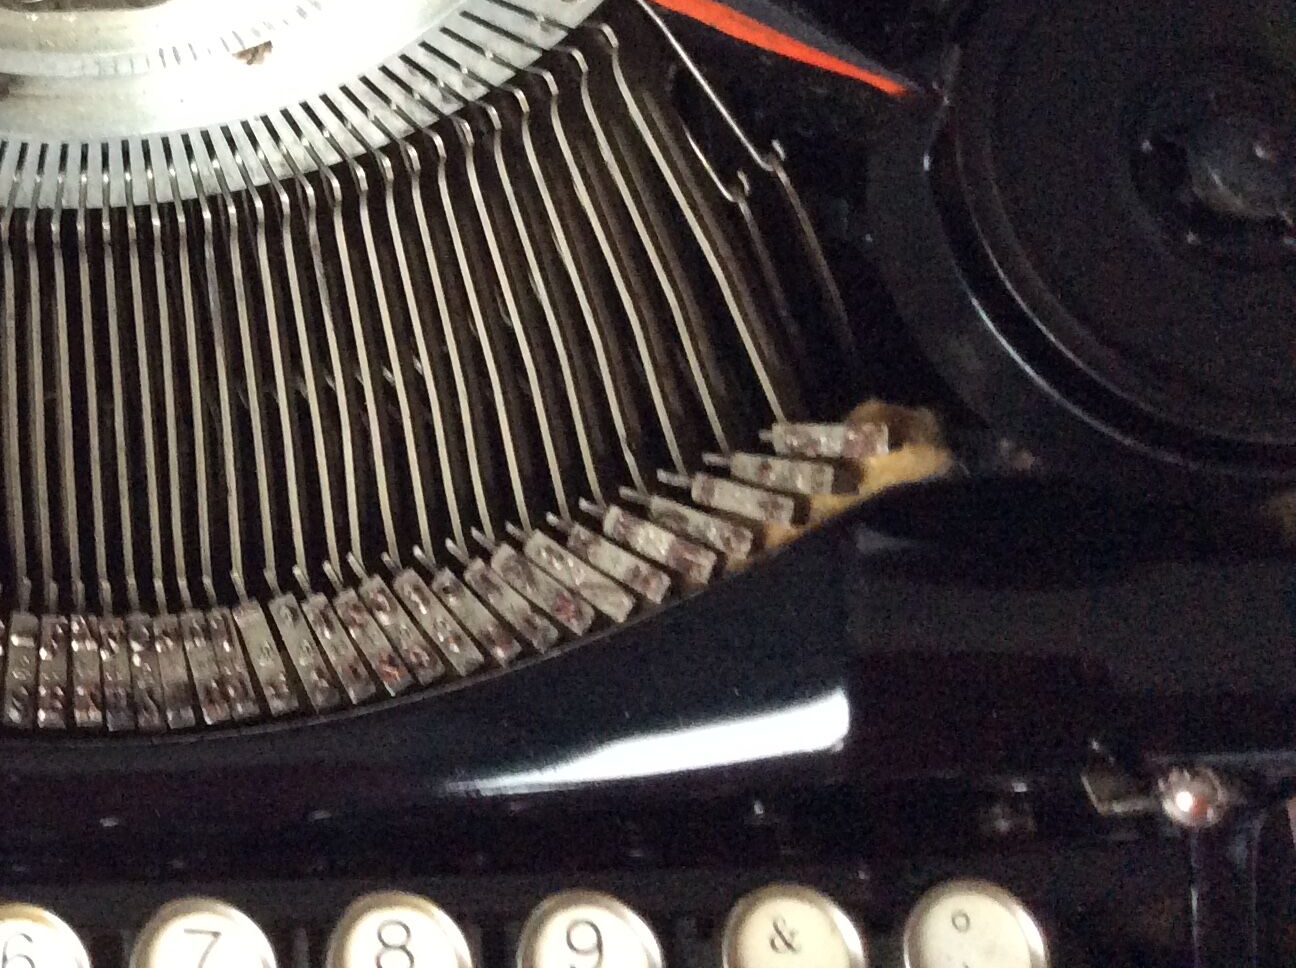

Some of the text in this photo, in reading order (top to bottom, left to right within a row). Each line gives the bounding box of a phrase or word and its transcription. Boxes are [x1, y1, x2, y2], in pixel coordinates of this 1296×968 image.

[0, 932, 36, 968] 6
[183, 928, 222, 968] 7
[375, 919, 415, 968] 8
[566, 919, 604, 968] 9
